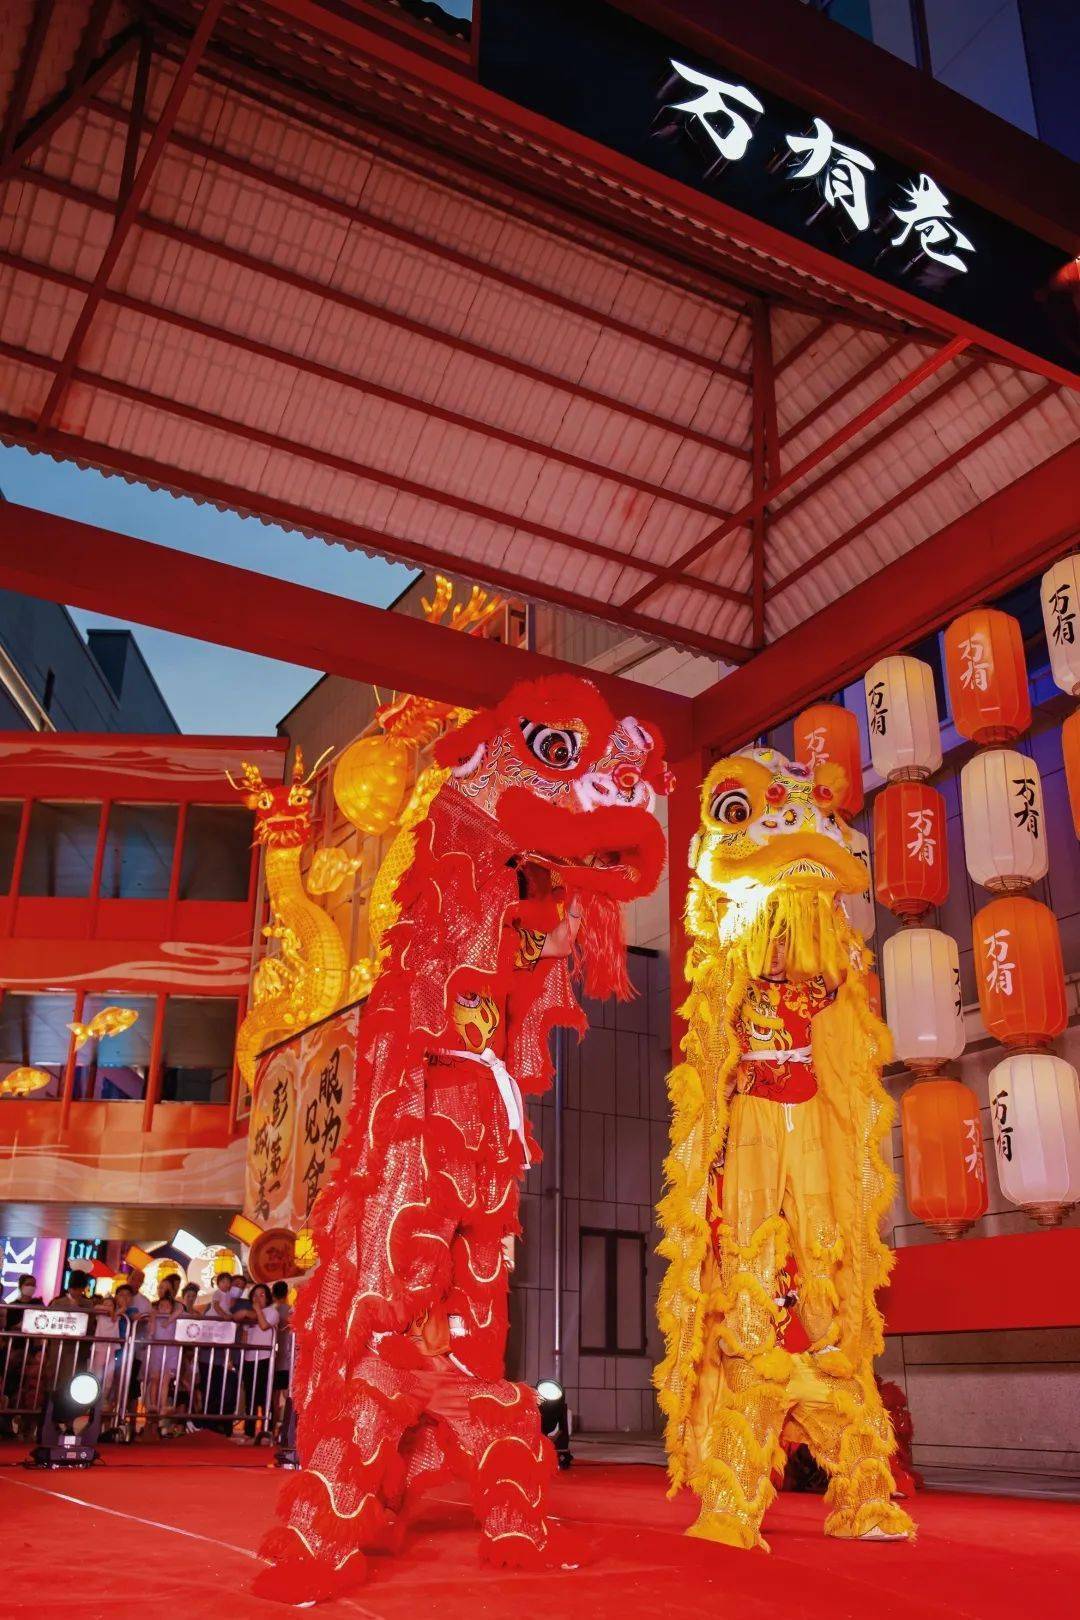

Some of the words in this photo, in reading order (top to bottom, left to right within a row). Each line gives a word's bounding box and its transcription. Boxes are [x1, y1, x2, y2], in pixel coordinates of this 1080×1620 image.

[1048, 583, 1077, 646] 万有
[957, 632, 992, 692] 万有
[867, 681, 889, 736] 万有
[906, 808, 937, 867] 万有
[1012, 778, 1040, 839] 万有
[983, 928, 1016, 996] 万有
[992, 1089, 1014, 1163] 万有
